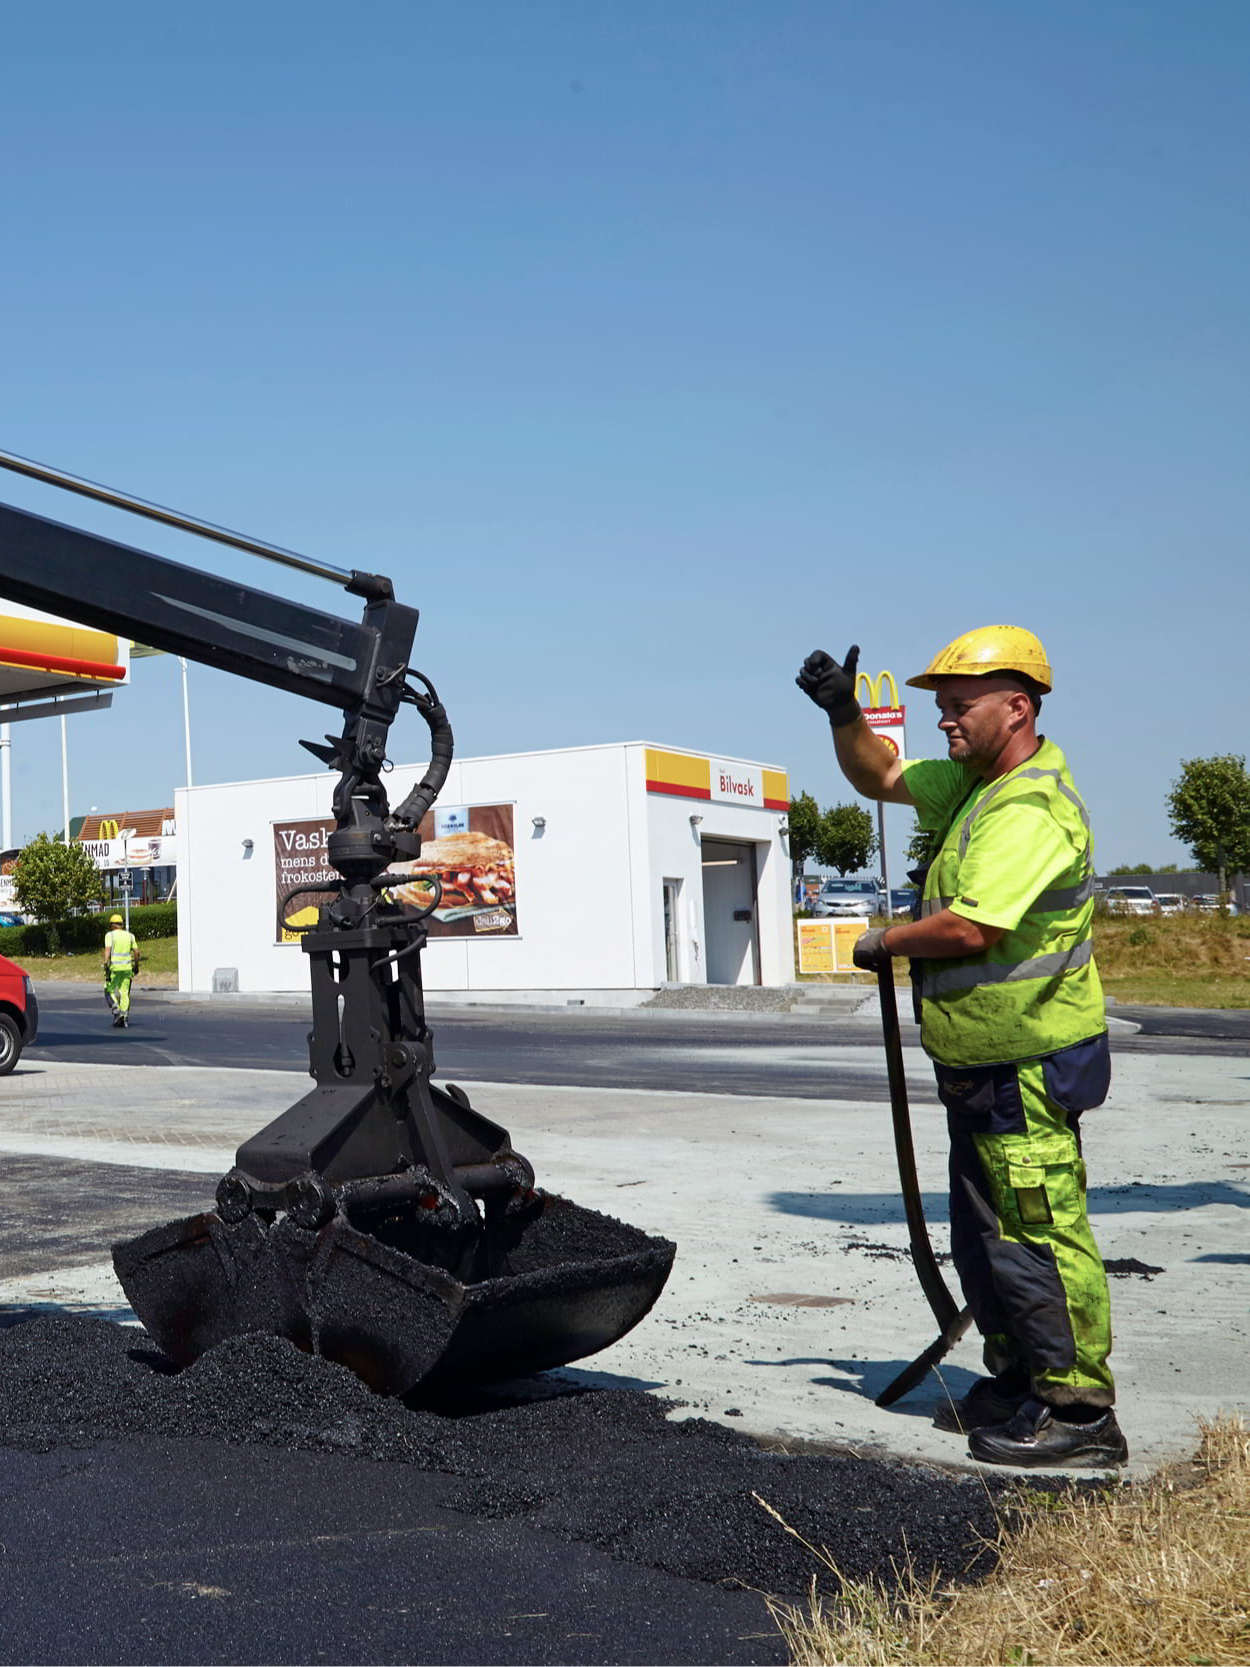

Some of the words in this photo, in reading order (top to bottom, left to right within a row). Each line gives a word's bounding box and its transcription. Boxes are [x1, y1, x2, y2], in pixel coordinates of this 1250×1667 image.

[720, 774, 754, 797] Bilvask
[281, 856, 315, 869] mens
[477, 913, 512, 926] deli2go
